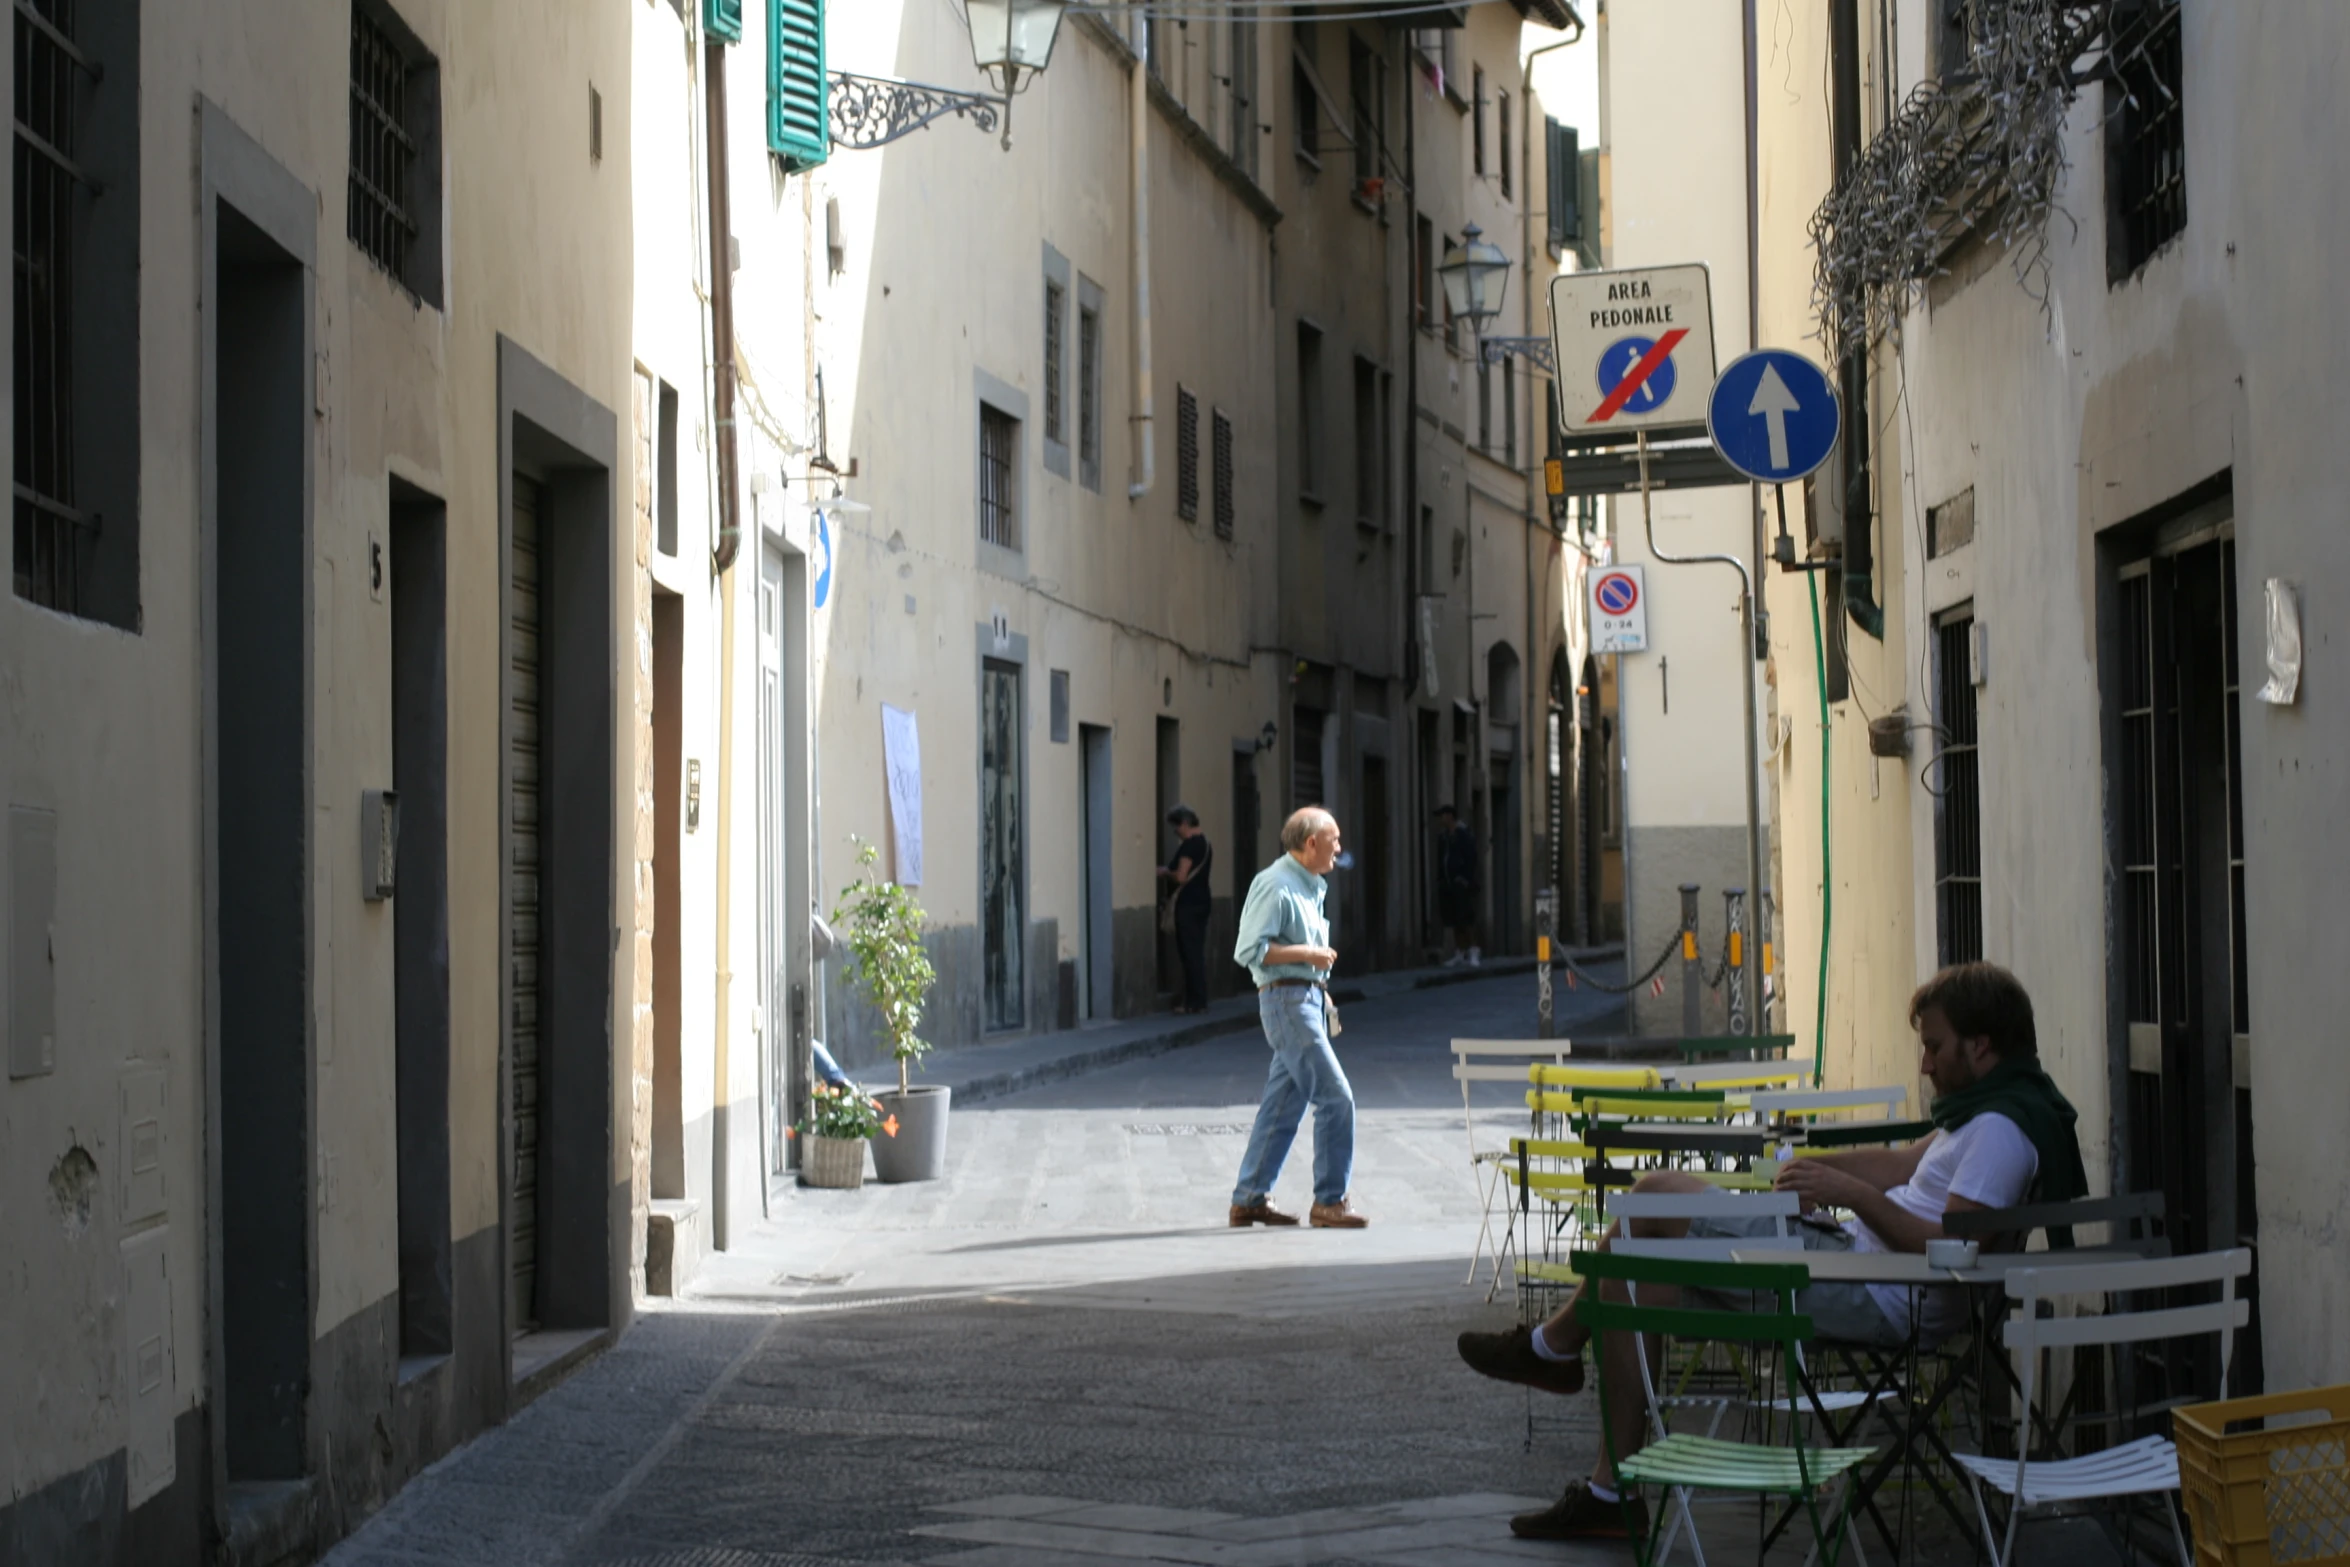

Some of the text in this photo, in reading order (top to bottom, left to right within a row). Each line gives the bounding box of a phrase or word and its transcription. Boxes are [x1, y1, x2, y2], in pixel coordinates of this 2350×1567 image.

[1608, 280, 1651, 301] AREA
[1590, 304, 1673, 329] PEDONALE
[372, 541, 382, 591] 5
